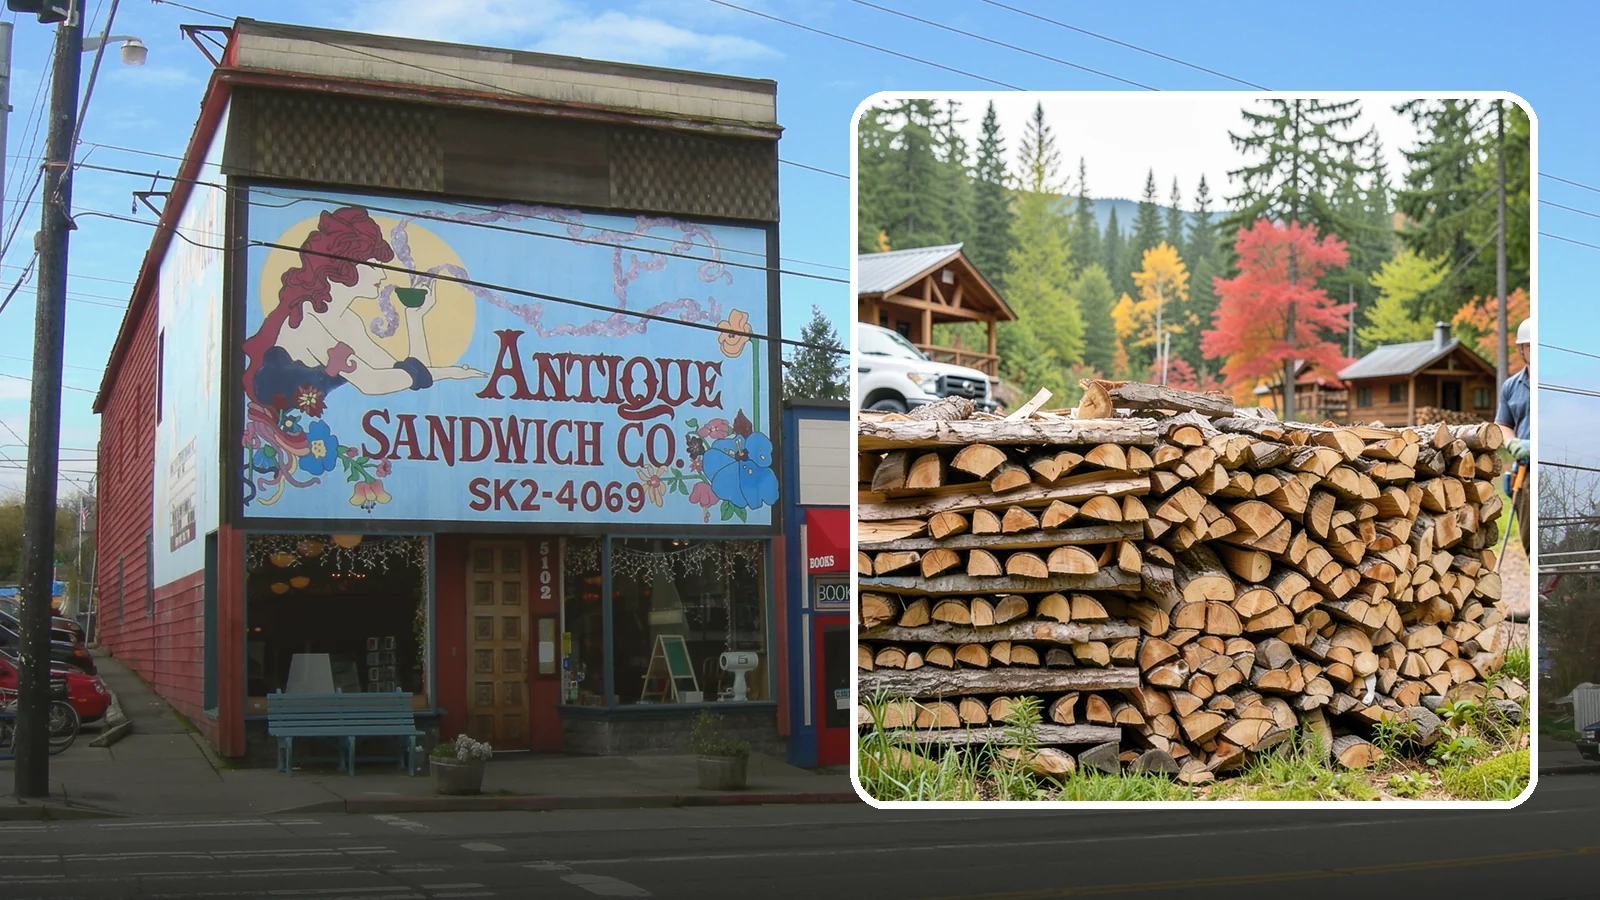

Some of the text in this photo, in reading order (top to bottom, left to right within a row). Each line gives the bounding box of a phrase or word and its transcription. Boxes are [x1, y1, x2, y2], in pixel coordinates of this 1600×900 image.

[476, 329, 723, 421] ANTIQUE
[361, 408, 685, 468] SANDWICH CO.
[468, 476, 646, 513] SK2-4069
[540, 542, 552, 600] 5102
[810, 556, 835, 568] BOOKS
